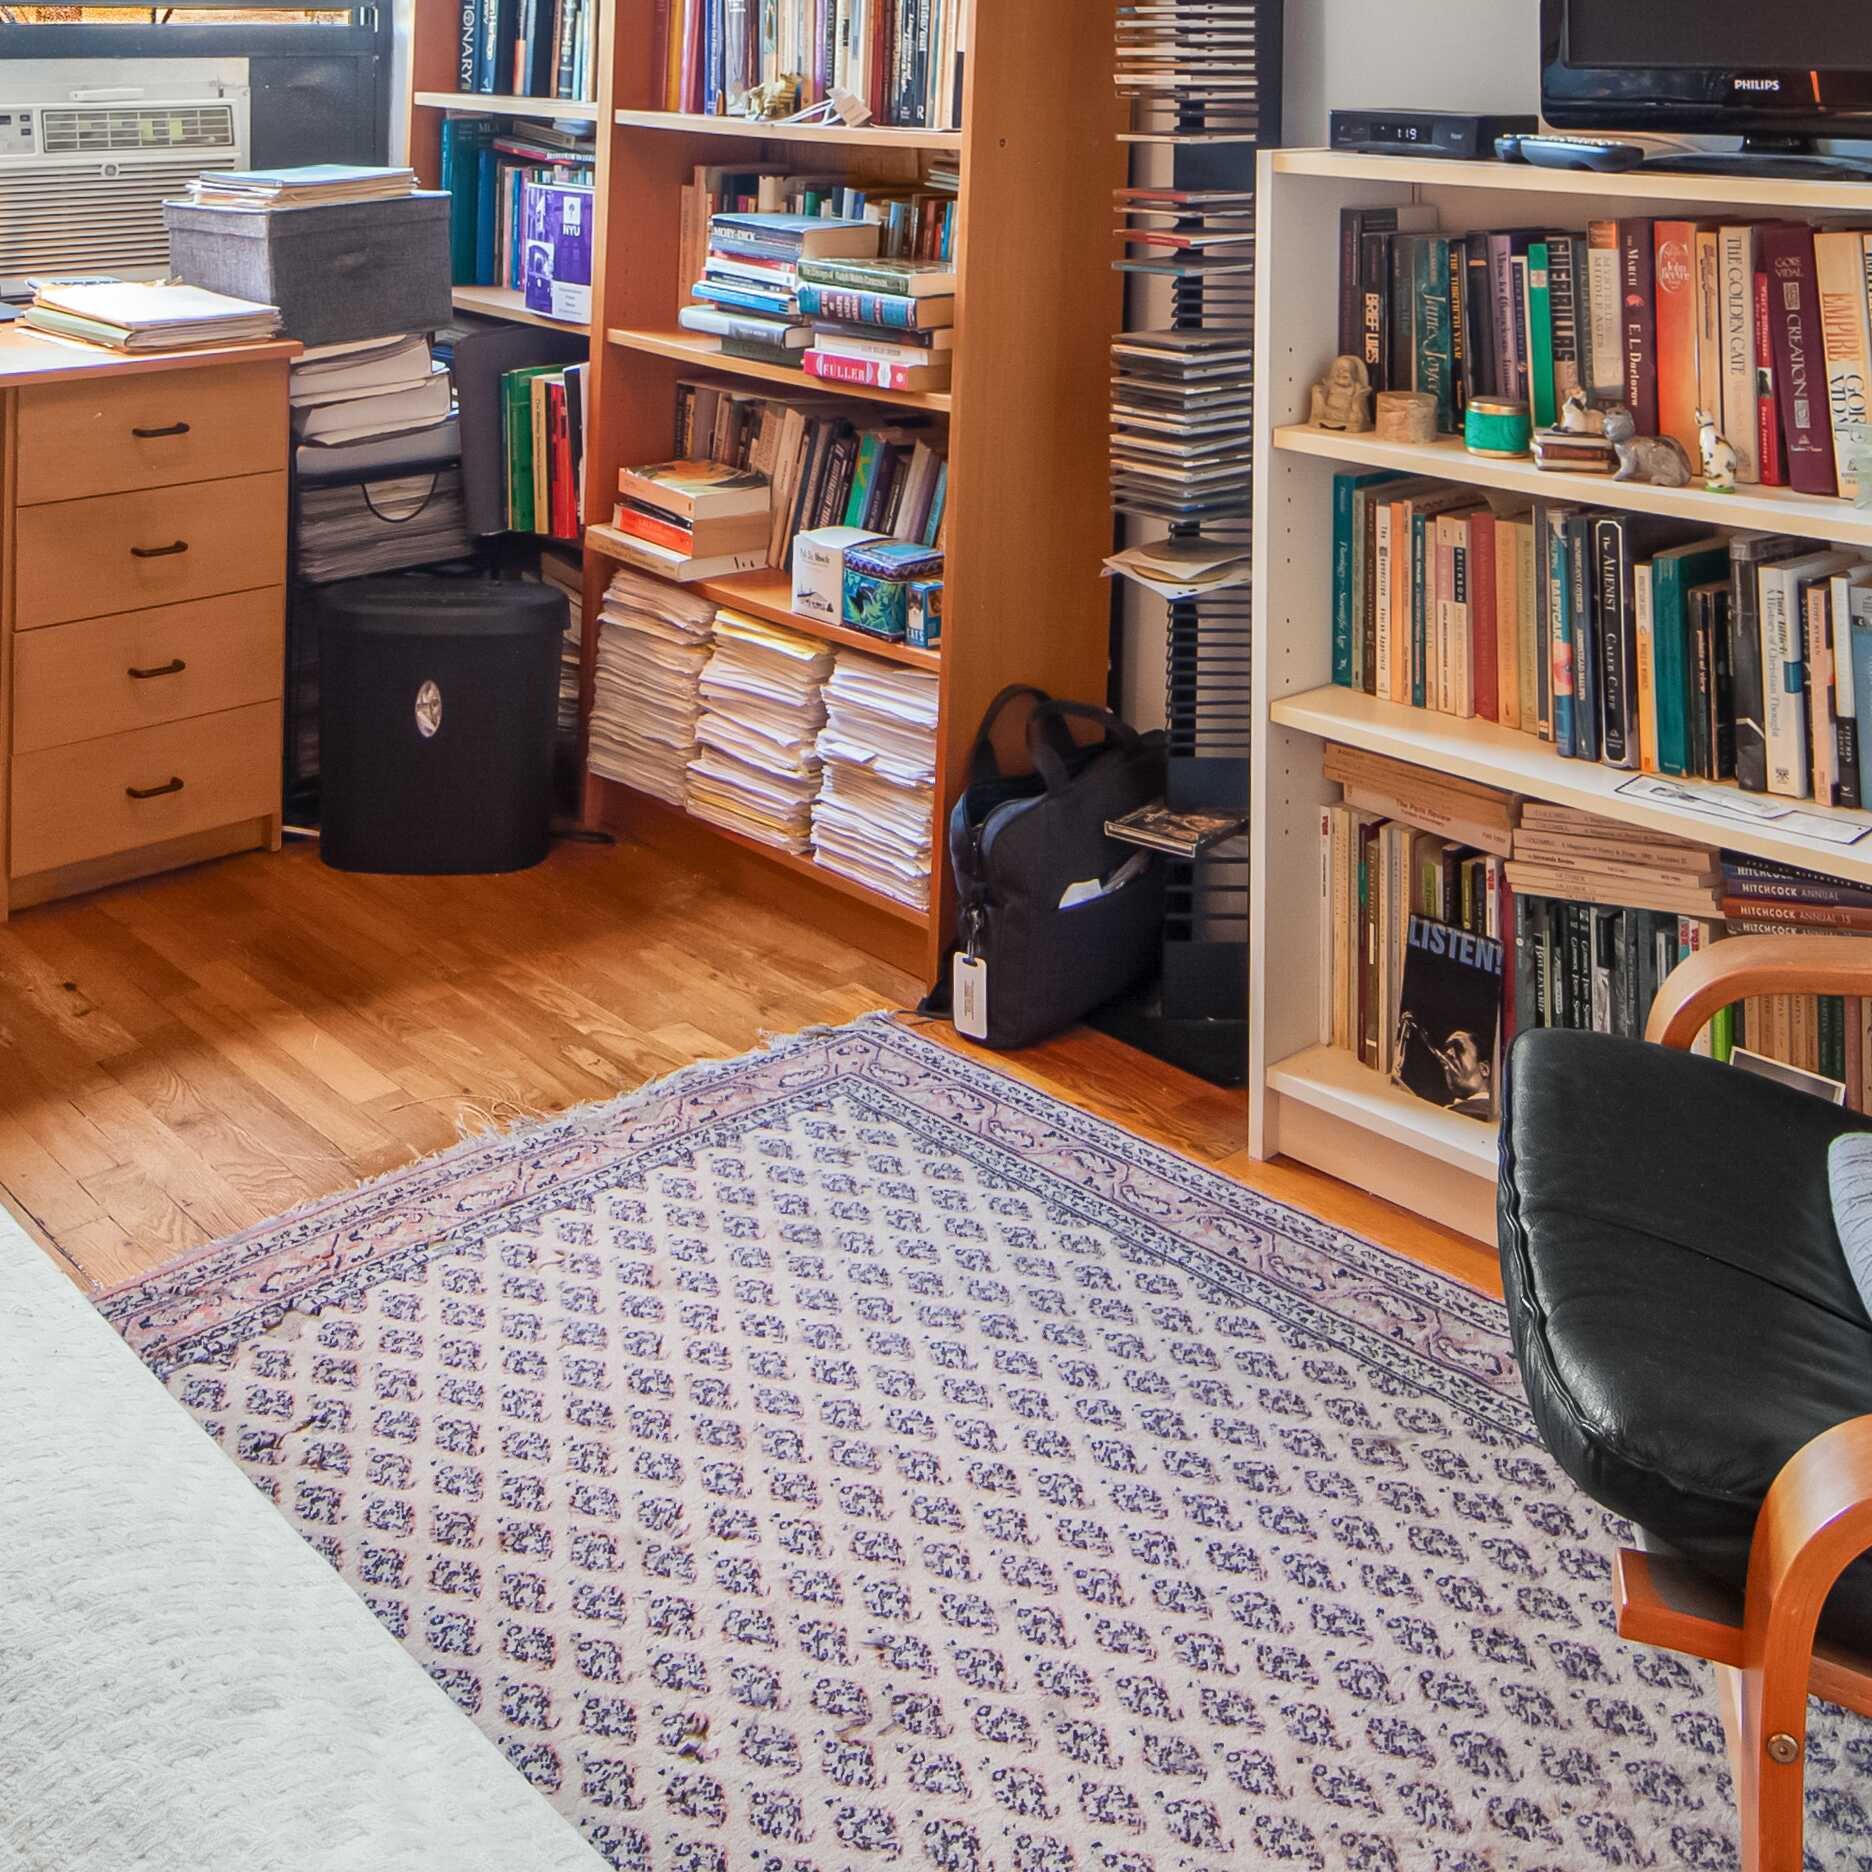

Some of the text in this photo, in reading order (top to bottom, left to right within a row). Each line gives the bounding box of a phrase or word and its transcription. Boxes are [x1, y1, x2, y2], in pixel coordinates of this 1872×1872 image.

[1734, 79, 1780, 91] PHILIPS
[563, 224, 581, 237] NYU
[712, 226, 756, 242] MOBY-DICK
[1450, 252, 1459, 270] THE
[1775, 257, 1802, 268] GORE
[1775, 268, 1804, 278] VIDAL
[1422, 283, 1446, 341] James
[1547, 240, 1577, 361] GUERRILLAS
[1727, 237, 1746, 376] THE GOLDEN GATE
[1364, 293, 1380, 364] BRIEF LIVES
[1823, 292, 1860, 362] EMPIRE
[822, 362, 866, 381] FULLER
[1786, 314, 1808, 397] CREATION
[1456, 548, 1464, 602] ERICKSON
[1602, 554, 1616, 613] ALIENIST
[1605, 633, 1618, 710] CALEB CARR
[1741, 882, 1840, 902] HITCHCOCK ANNUAL
[1739, 904, 1796, 920] HITCHCOCK
[1798, 912, 1838, 923] ANNUAL
[1742, 921, 1798, 936] HITCHCOCK
[1409, 913, 1505, 976] LISTEN!
